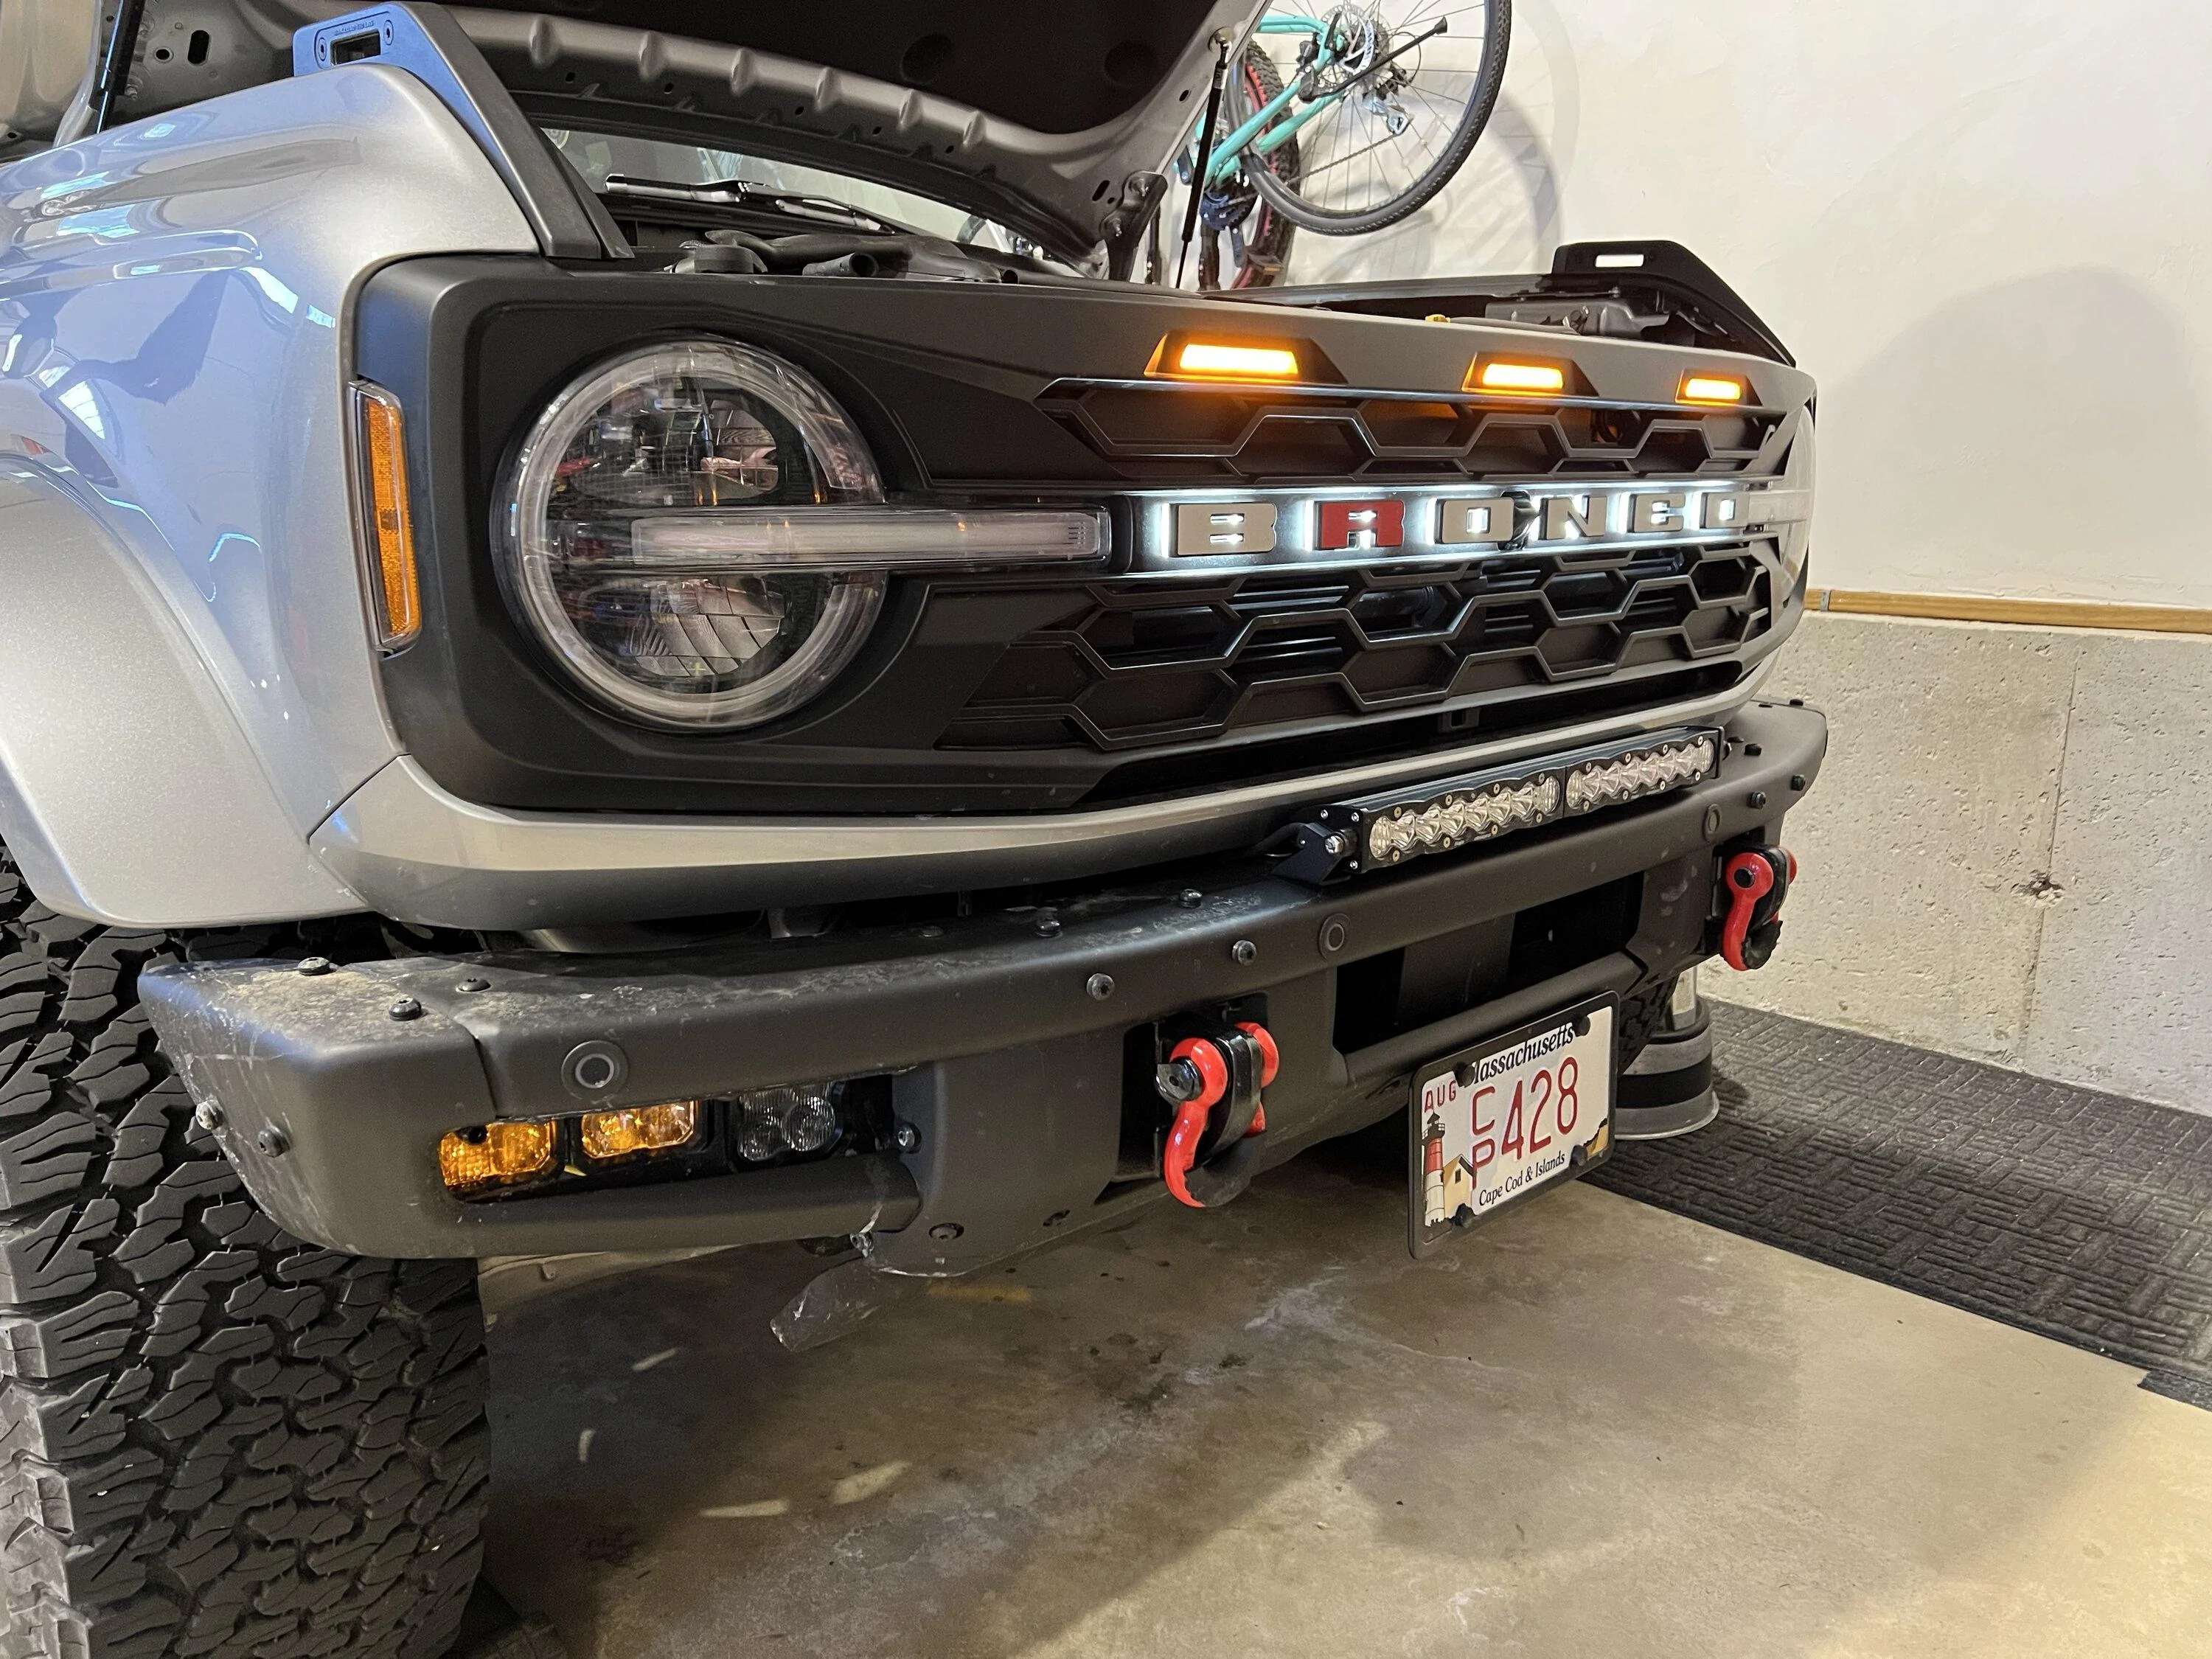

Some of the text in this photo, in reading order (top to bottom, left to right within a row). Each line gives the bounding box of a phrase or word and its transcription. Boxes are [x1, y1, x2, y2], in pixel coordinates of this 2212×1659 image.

[1171, 491, 1750, 557] BRONCO
[1425, 1080, 1456, 1113] AUG
[1479, 1150, 1565, 1206] Cape Cod & Islands
